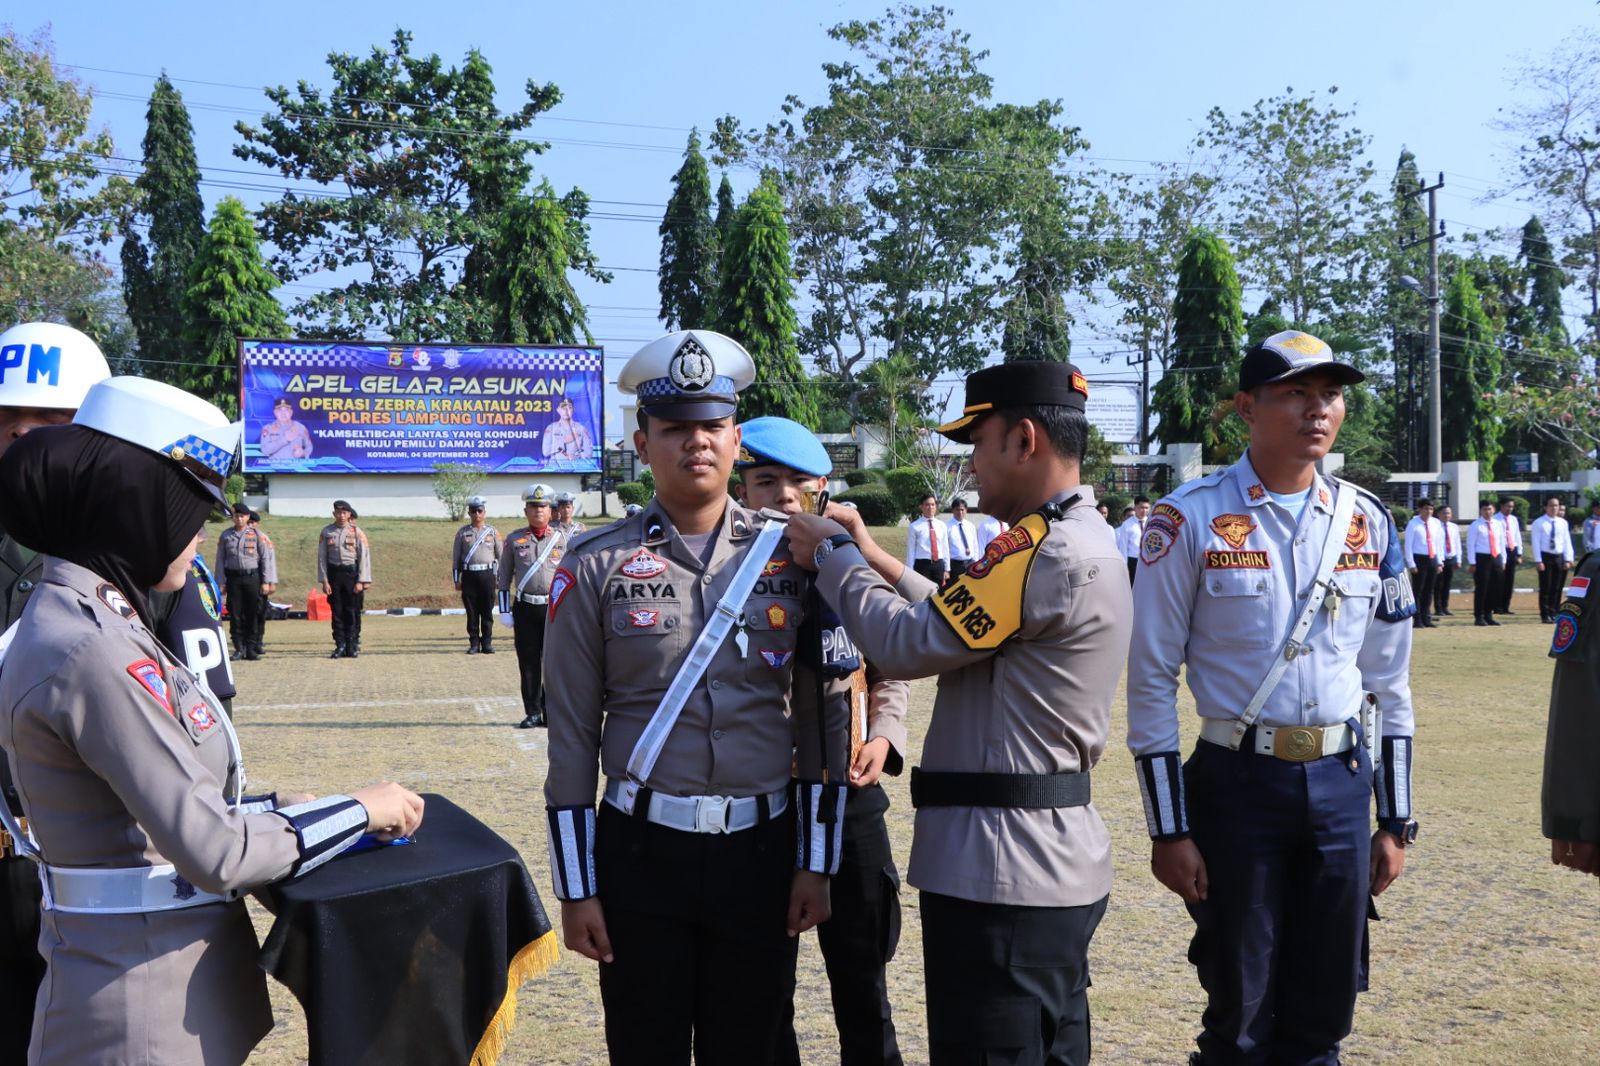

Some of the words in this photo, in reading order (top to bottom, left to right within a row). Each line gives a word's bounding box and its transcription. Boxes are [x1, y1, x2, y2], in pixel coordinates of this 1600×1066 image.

[0, 343, 62, 386] PM
[286, 374, 354, 393] APEL
[360, 375, 443, 394] GELAR
[449, 377, 566, 395] PASUKAN
[299, 397, 370, 411] OPERASI
[374, 398, 427, 411] ZEBRA
[431, 399, 510, 412] KRAKATAU
[514, 400, 552, 412] 2023
[328, 411, 391, 424] POLRES
[395, 412, 472, 425] LAMPUNG
[476, 413, 526, 425] UTARA
[345, 439, 391, 448] MENUJU
[394, 440, 436, 448] PEMILU
[439, 440, 475, 449] DAMAI
[408, 430, 449, 438] LANTAS
[452, 430, 482, 439] YANG
[484, 430, 540, 439] KONDUSIF
[1209, 552, 1266, 567] SOLIHIN
[614, 583, 676, 600] ARYA
[754, 578, 799, 597] OLRI
[1383, 567, 1416, 614] PA
[943, 584, 975, 616] OPS
[959, 605, 996, 640] RES
[821, 625, 858, 664] PA
[181, 626, 235, 690] P
